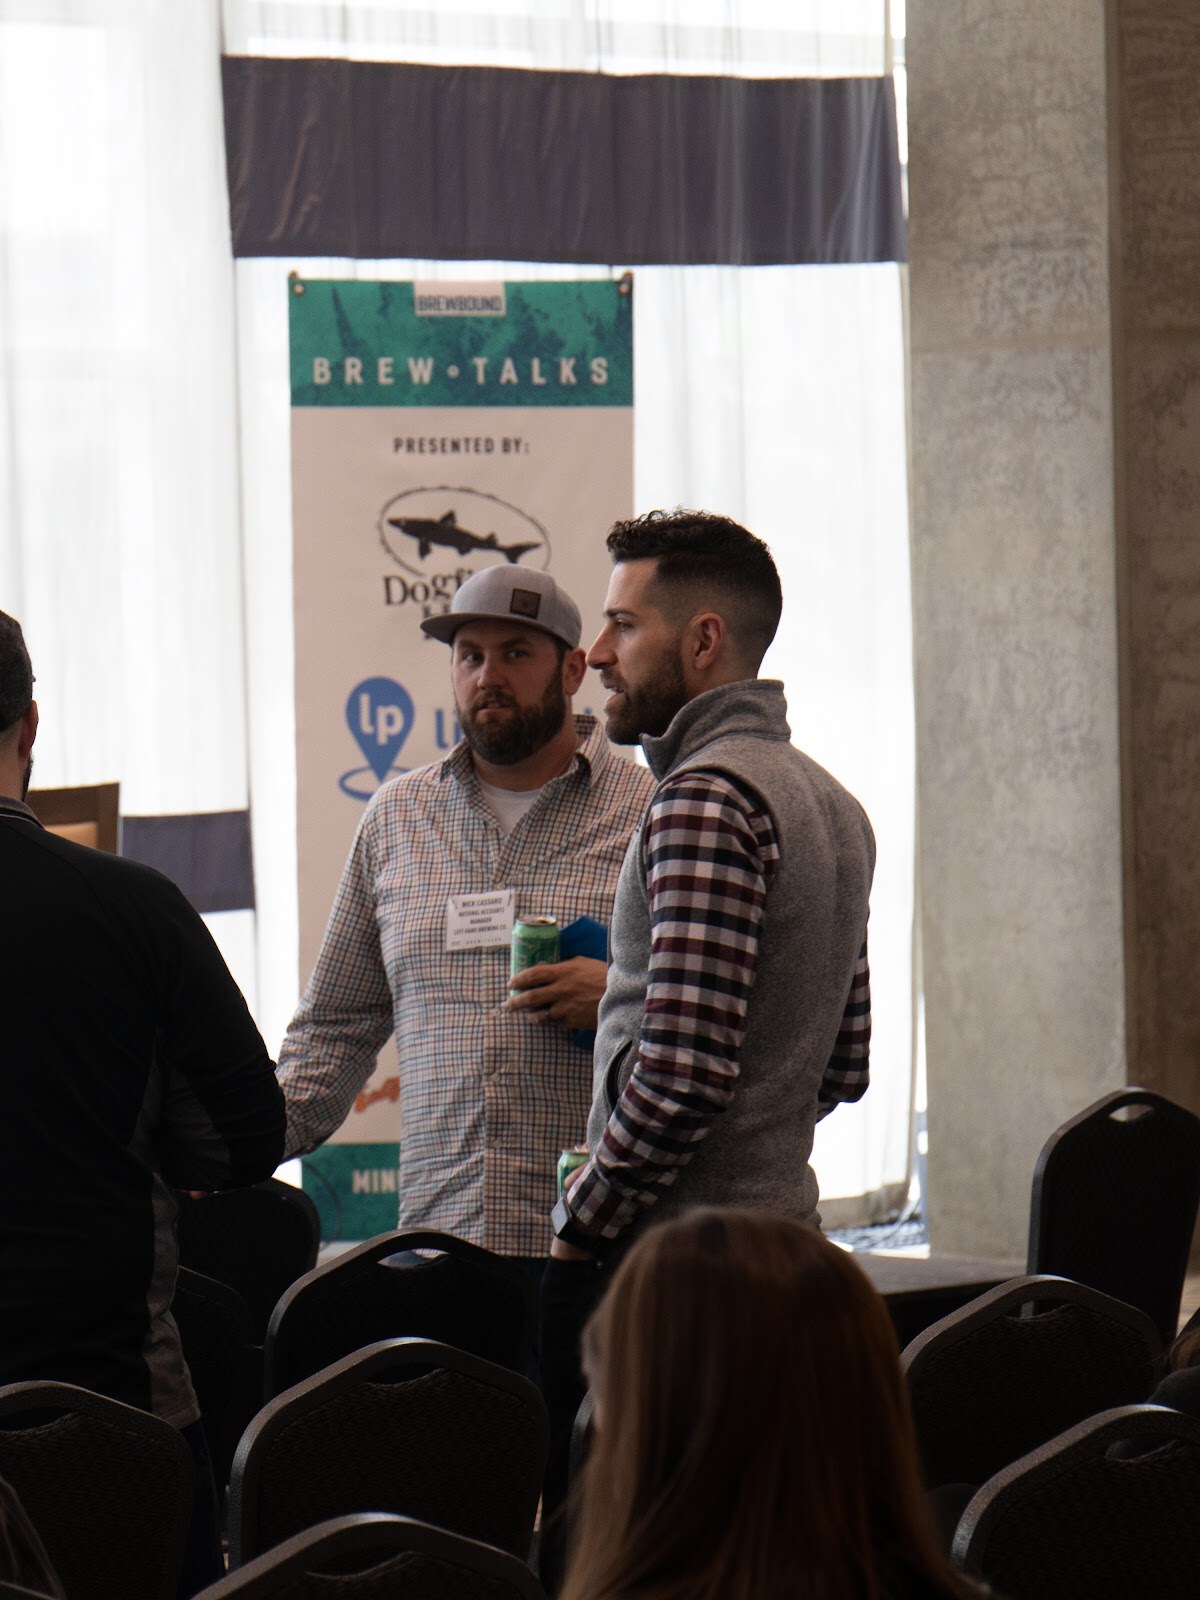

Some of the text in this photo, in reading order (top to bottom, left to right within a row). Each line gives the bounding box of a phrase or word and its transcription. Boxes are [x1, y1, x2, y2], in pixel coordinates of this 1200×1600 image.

[417, 295, 503, 311] BREWBOUND
[312, 357, 609, 385] BREW TALKS
[393, 437, 530, 454] PRESENTED BY:
[383, 567, 473, 606] Dogf
[358, 692, 405, 746] lp
